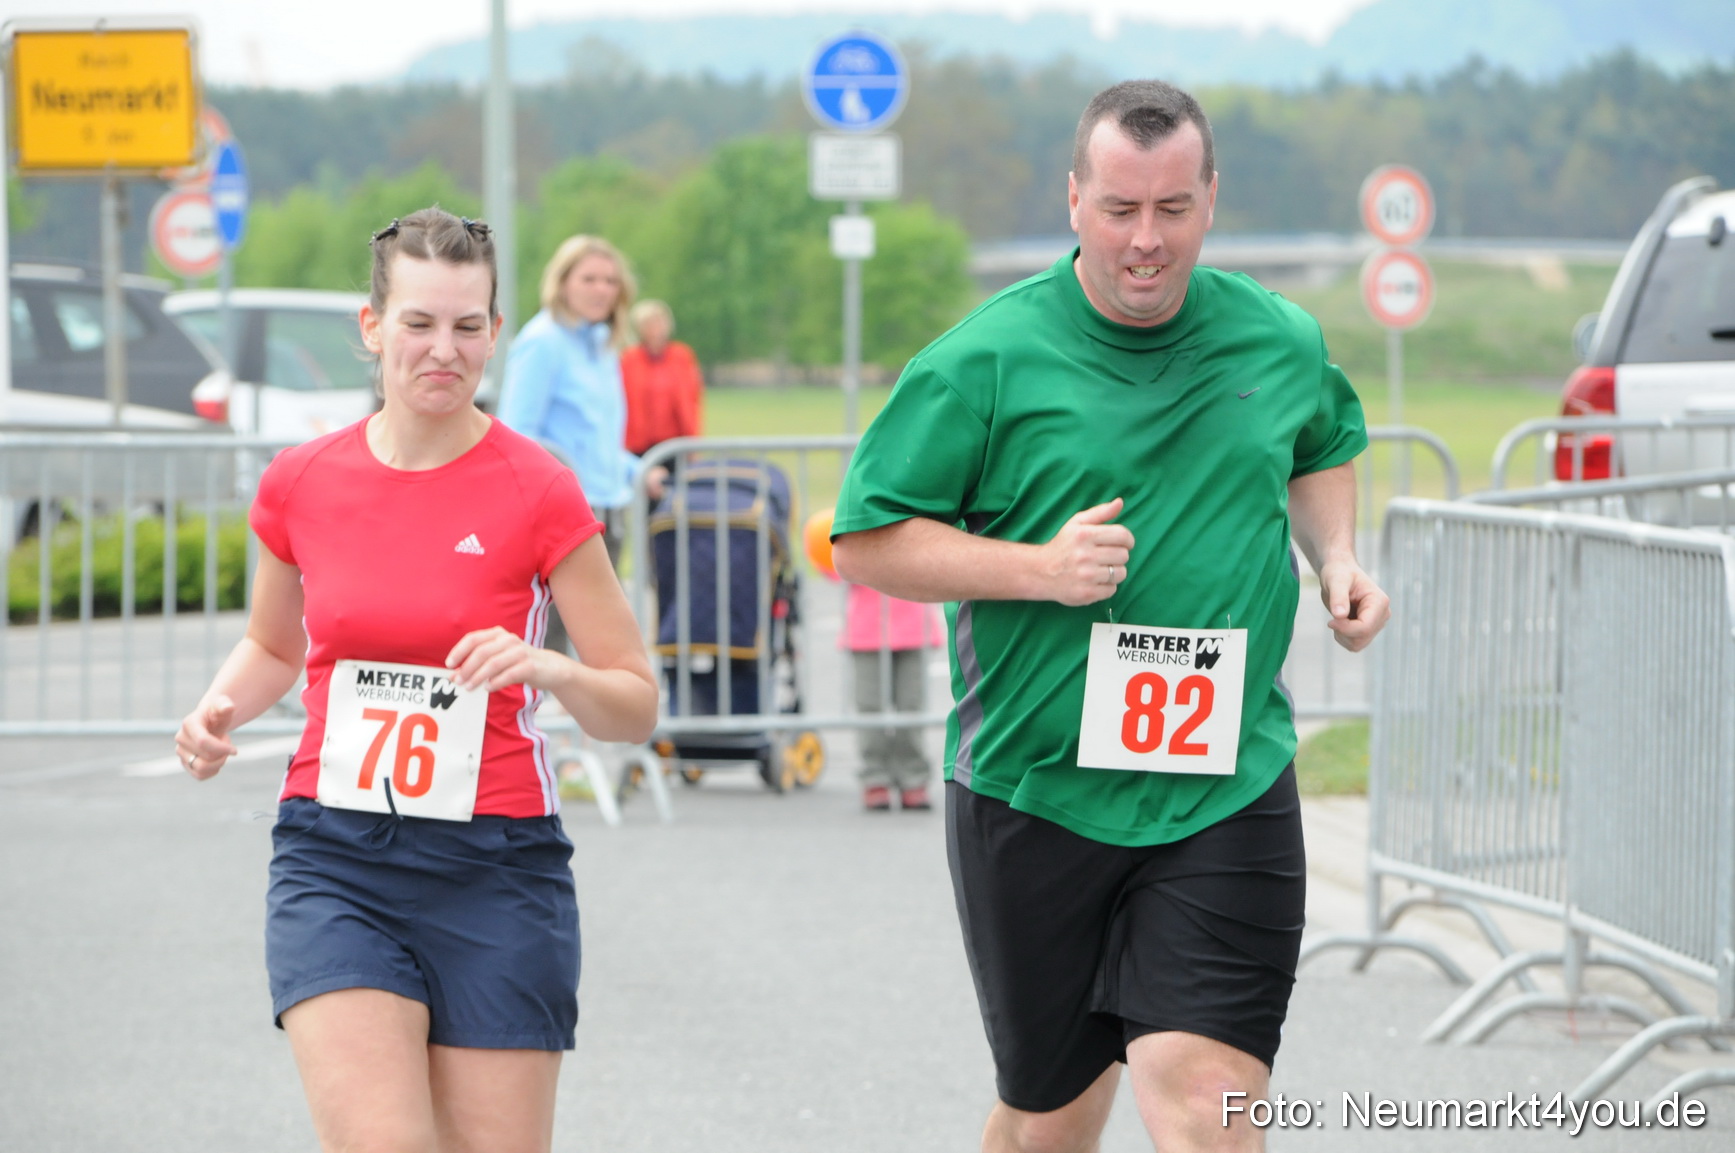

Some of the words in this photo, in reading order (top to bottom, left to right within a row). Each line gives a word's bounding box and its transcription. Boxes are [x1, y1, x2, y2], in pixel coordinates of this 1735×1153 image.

[1117, 632, 1191, 653] MEYER
[1117, 649, 1190, 666] WERBUNG
[356, 669, 426, 690] MEYER
[356, 687, 424, 704] WERBUNG
[1121, 671, 1215, 756] 82
[357, 707, 439, 799] 76
